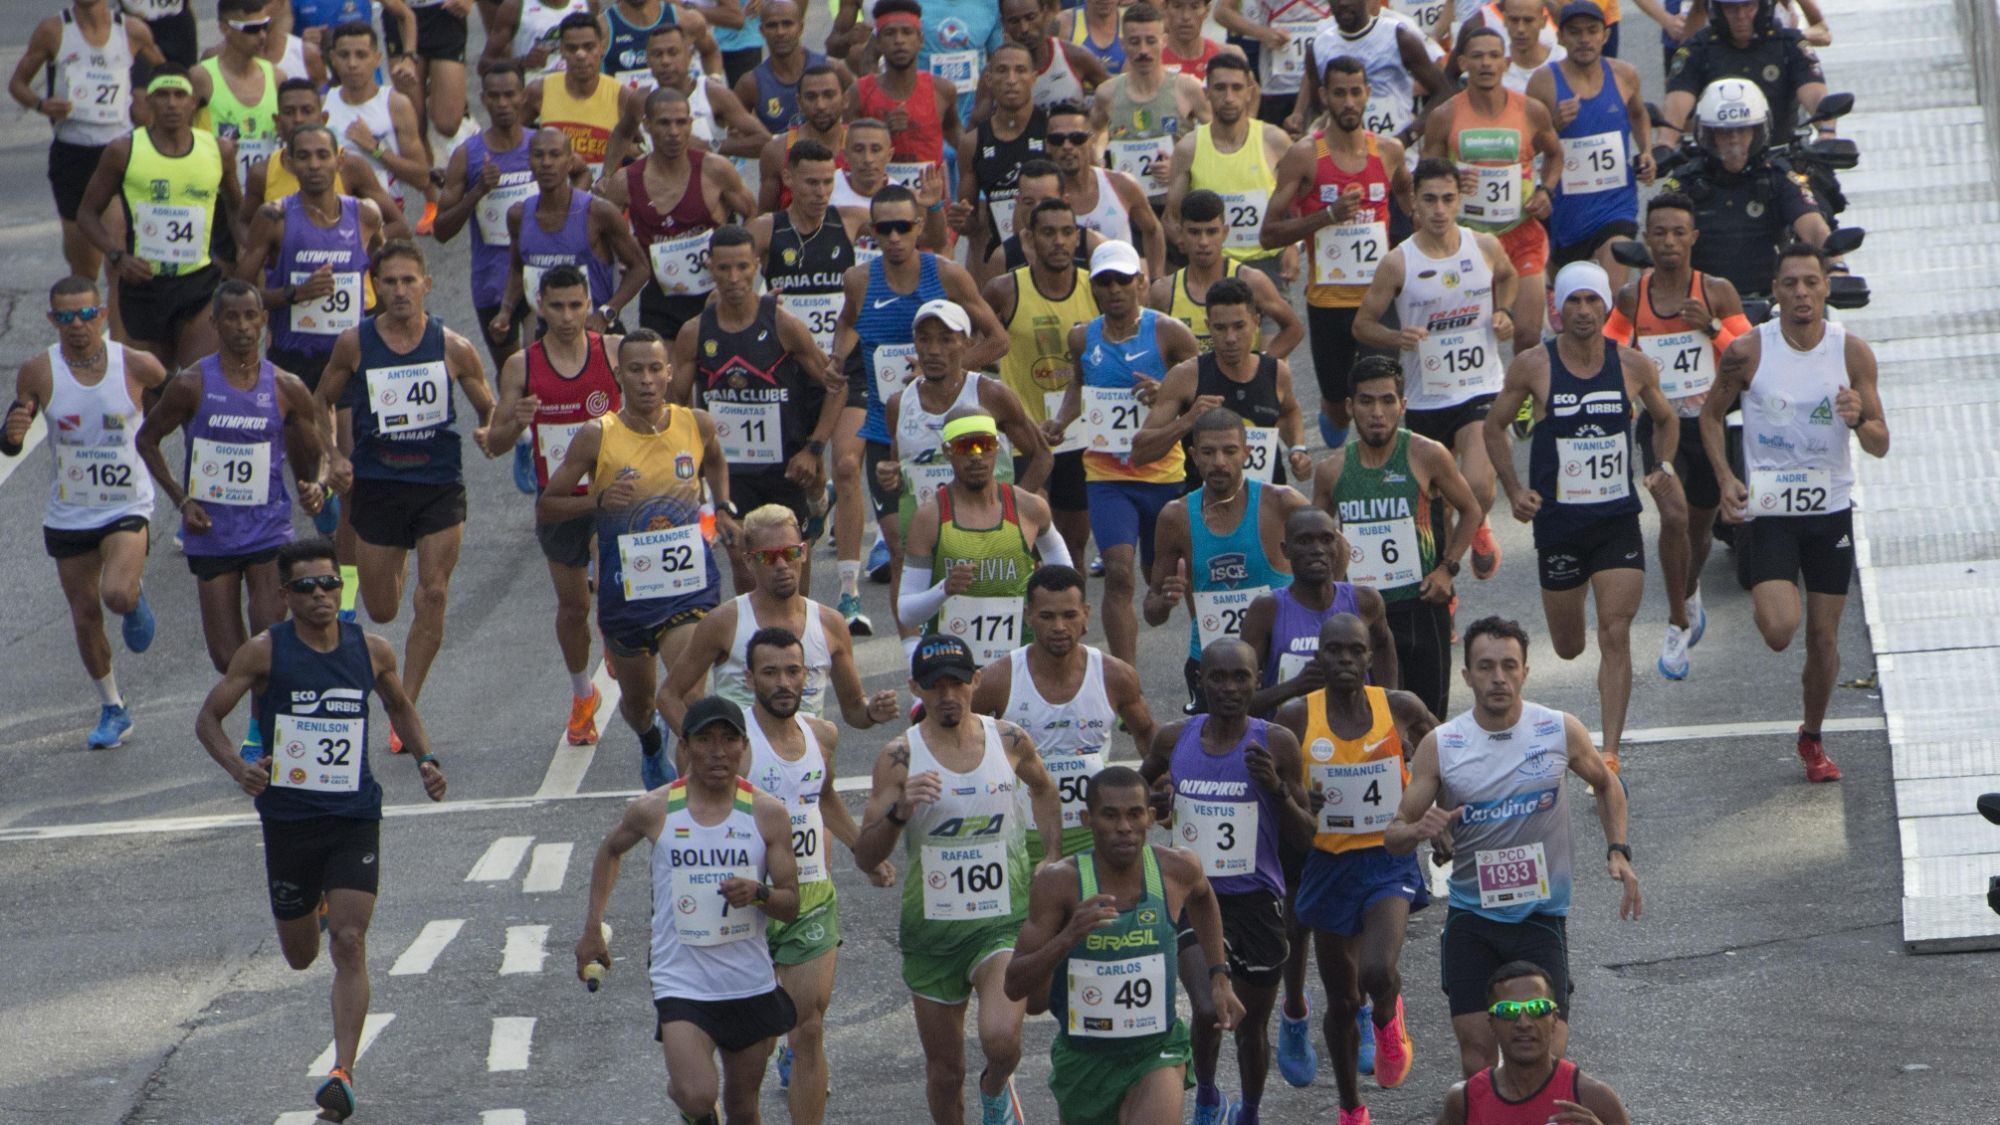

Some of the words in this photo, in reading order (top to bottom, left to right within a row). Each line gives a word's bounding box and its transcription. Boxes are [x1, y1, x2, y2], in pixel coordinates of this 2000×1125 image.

[96, 84, 120, 105] 27
[1717, 107, 1751, 120] GCM
[1588, 149, 1615, 172] 15
[1486, 181, 1510, 202] 31
[152, 207, 190, 218] ADRIANO
[1230, 206, 1258, 227] 23
[166, 220, 193, 243] 34
[1334, 226, 1371, 237] JULIANO
[295, 250, 353, 264] OLYMPIKUS
[1350, 239, 1378, 263] 12
[321, 289, 350, 313] 39
[792, 297, 831, 307] GLEISON
[809, 311, 838, 335] 35
[1657, 335, 1694, 348] CARLOS
[1443, 346, 1485, 373] 150
[1674, 347, 1702, 374] 47
[387, 367, 430, 380] ANTONIO
[406, 381, 437, 406] 40
[740, 388, 789, 402] CLUBE
[1553, 393, 1578, 405] ECO
[1112, 405, 1139, 430] 21
[1586, 403, 1623, 415] URBIS
[208, 414, 268, 430] OLYMPIKUS
[740, 420, 766, 442] 11
[215, 445, 254, 456] GIOVANI
[1573, 439, 1616, 451] IVANILDO
[75, 450, 118, 460] ANTONIO
[223, 460, 253, 483] 19
[1585, 451, 1623, 480] 151
[86, 464, 132, 487] 162
[1775, 473, 1808, 483] ANDRE
[1338, 497, 1411, 521] BOLIVIA
[1781, 487, 1827, 512] 152
[633, 529, 691, 546] ALEXANDRE
[1359, 524, 1392, 536] RUBEN
[662, 544, 694, 573] 52
[1381, 538, 1399, 564] 6
[1211, 564, 1248, 582] ISCE
[1213, 593, 1247, 605] SAMUR
[970, 614, 1015, 641] 171
[921, 641, 964, 659] Diniz
[291, 690, 317, 702] ECO
[326, 702, 361, 713] URBIS
[296, 720, 349, 733] RENILSON
[316, 738, 351, 766] 32
[1327, 762, 1387, 778] EMMANUEL
[1059, 774, 1090, 804] 50
[1179, 779, 1249, 797] OLYMPIKUS
[1362, 779, 1382, 806] 4
[1193, 803, 1235, 817] VESTUS
[790, 814, 808, 826] OSE
[792, 828, 816, 857] 20
[1216, 822, 1236, 851] 3
[671, 848, 749, 868] BOLIVIA
[941, 849, 983, 861] RAFAEL
[1498, 848, 1526, 862] PCD
[689, 872, 735, 885] HECTOR
[950, 861, 1003, 895] 160
[1487, 862, 1530, 885] 1933
[1086, 928, 1159, 951] BRASIL
[1096, 962, 1142, 976] CARLOS
[1114, 978, 1152, 1010] 49
